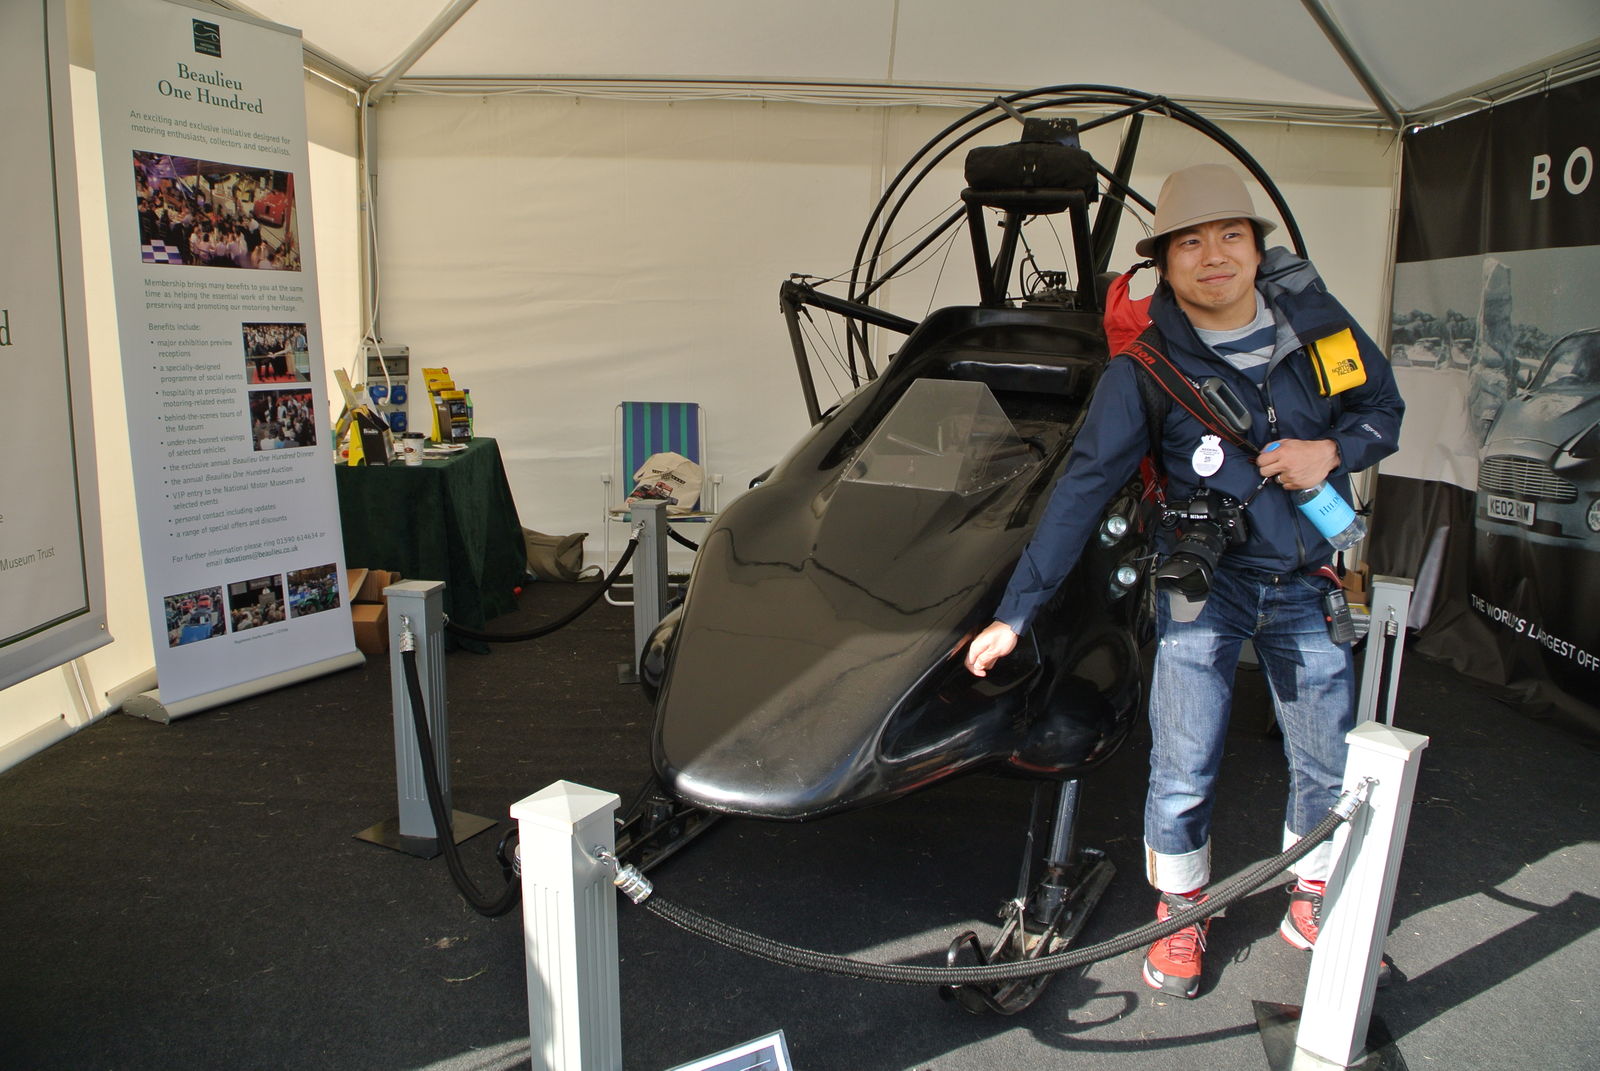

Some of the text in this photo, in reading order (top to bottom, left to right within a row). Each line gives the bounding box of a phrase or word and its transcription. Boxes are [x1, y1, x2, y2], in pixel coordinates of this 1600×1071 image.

[177, 63, 243, 91] Beaulieu
[158, 80, 264, 114] One Hundred
[130, 110, 291, 144] An exciting and exclusive initiative designed for
[131, 124, 166, 137] motoring
[167, 129, 208, 144] enthusiasts,
[209, 137, 242, 149] collectors
[243, 142, 256, 151] and
[144, 279, 186, 289] Membership
[187, 281, 207, 290] brings
[226, 282, 249, 290] benefits
[145, 290, 161, 298] time
[174, 291, 198, 300] helping
[200, 291, 210, 299] the
[212, 292, 238, 300] essential
[146, 301, 182, 310] preserving
[184, 302, 196, 310] and
[197, 303, 229, 311] promoting
[242, 303, 270, 312] motoring
[148, 322, 176, 331] Benefits
[157, 338, 233, 347] major exhibition preview
[158, 350, 191, 358] receptions
[165, 363, 221, 373] specially-designed
[160, 375, 197, 384] programme
[198, 373, 205, 381] of
[206, 373, 223, 381] social
[162, 388, 195, 397] hospitality
[204, 386, 237, 396] prestigious
[163, 397, 235, 408] motoring-related events
[164, 412, 219, 422] behind-the-scenes
[165, 424, 204, 433] the Museum
[220, 434, 245, 442] viewings
[168, 446, 226, 458] of selected vehicles
[169, 463, 181, 472] the
[181, 461, 209, 470] exclusive
[210, 460, 230, 468] annual
[232, 456, 258, 465] Beaulieu
[258, 454, 270, 462] One
[271, 452, 296, 461] Hundred
[171, 465, 293, 486] the annual Beaulieu One Hundred Auction
[172, 490, 185, 499] VIP
[186, 488, 203, 498] entry
[212, 486, 222, 494] the
[224, 483, 249, 493] National
[251, 480, 268, 489] Motor
[269, 478, 294, 487] Museum
[295, 476, 306, 484] and
[173, 498, 218, 510] selected events
[174, 503, 276, 524] personal contact including updates
[182, 528, 200, 537] range
[201, 526, 208, 534] of
[208, 523, 230, 533] special
[231, 521, 248, 530] offers
[249, 518, 260, 527] and
[261, 515, 287, 525] discounts
[172, 555, 183, 564] For
[185, 551, 207, 562] further
[208, 545, 243, 557] information
[244, 542, 262, 552] please
[263, 539, 276, 548] ring
[0, 547, 55, 571] Museum Trust
[206, 560, 223, 568] email
[1471, 594, 1485, 613] THE
[1527, 623, 1576, 660] LARGEST
[1577, 650, 1600, 671] OFF
